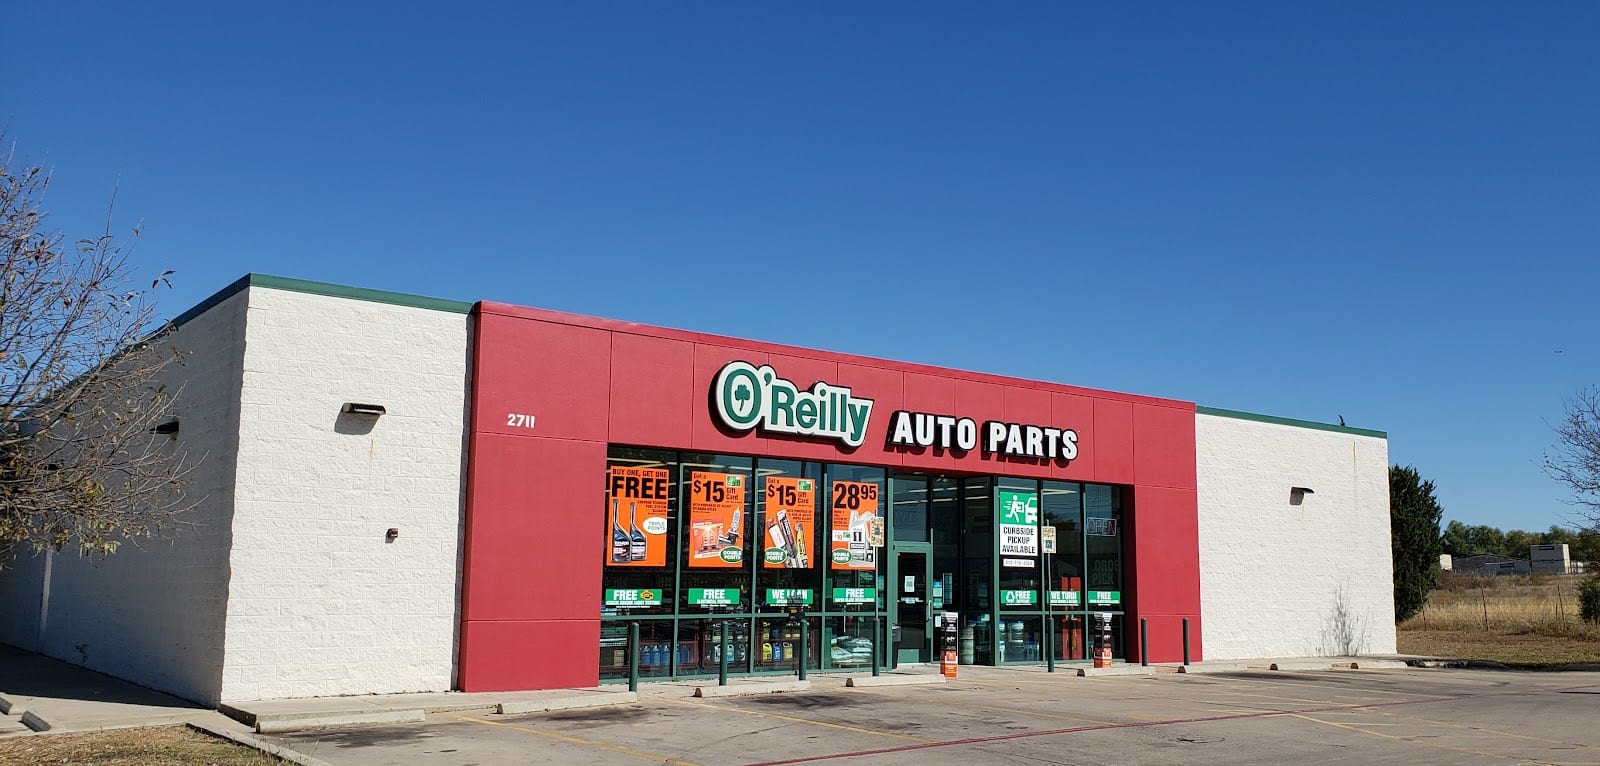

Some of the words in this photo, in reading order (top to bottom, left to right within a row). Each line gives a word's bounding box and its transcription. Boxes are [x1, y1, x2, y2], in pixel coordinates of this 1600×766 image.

[724, 369, 869, 441] O'Reilly
[507, 413, 535, 428] 2711
[893, 412, 976, 450] AUTO
[989, 422, 1078, 460] PARTS
[612, 476, 667, 499] FREE
[693, 480, 724, 503] $15
[768, 484, 796, 506] $15
[1003, 526, 1035, 536] CURBSIDE
[1088, 519, 1115, 534] OPEN
[1007, 536, 1030, 545] PICKUP
[1002, 545, 1037, 554] AVAILABLE
[613, 589, 638, 600] FREE
[703, 588, 726, 599] FREE
[771, 589, 784, 600] WE
[787, 589, 808, 600] LOAN
[845, 588, 864, 598] FREE
[1014, 590, 1031, 600] FREE
[1050, 591, 1060, 600] WE
[1061, 591, 1077, 600] TURN
[1096, 591, 1111, 600] FREE
